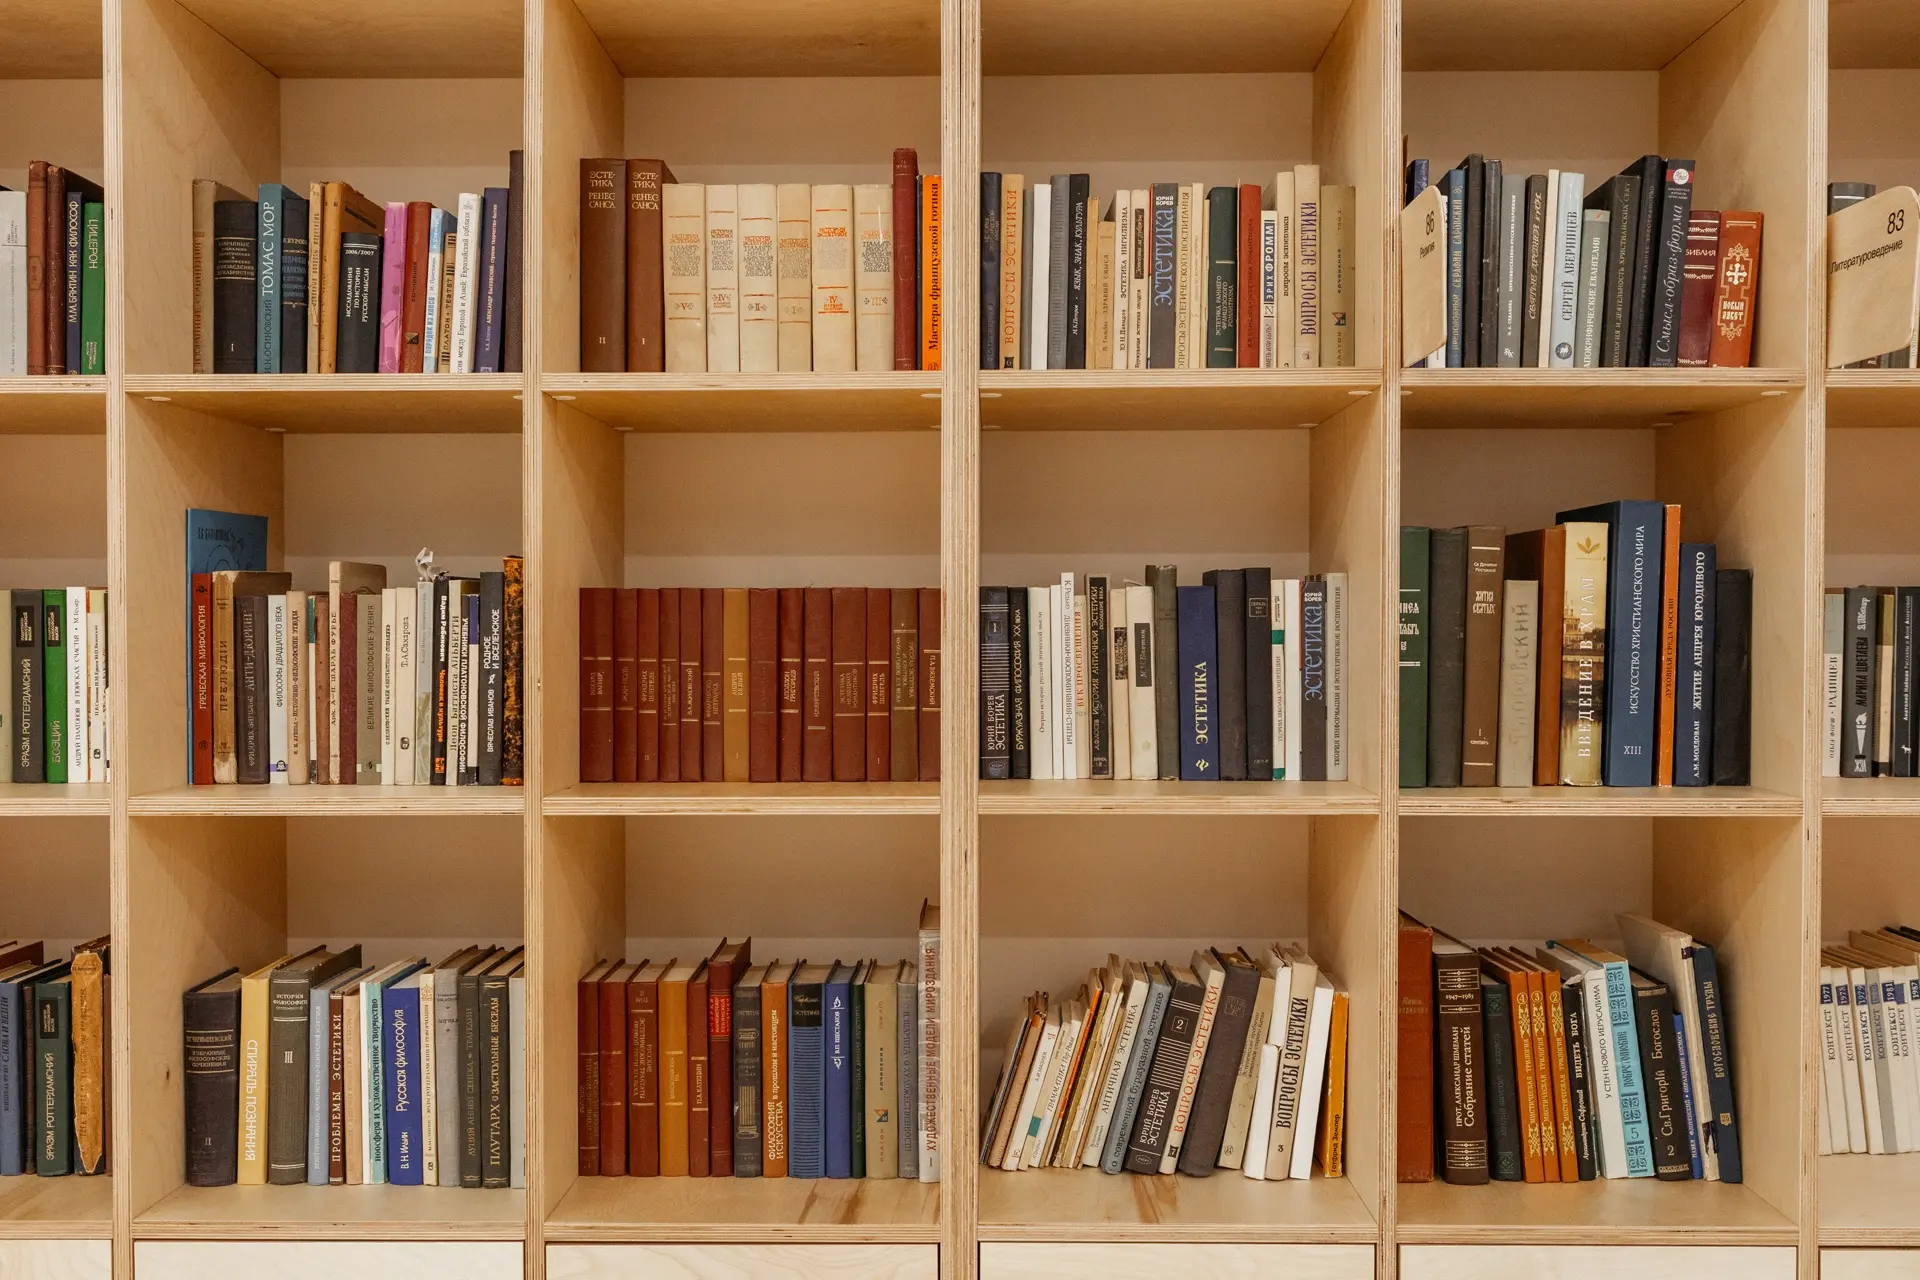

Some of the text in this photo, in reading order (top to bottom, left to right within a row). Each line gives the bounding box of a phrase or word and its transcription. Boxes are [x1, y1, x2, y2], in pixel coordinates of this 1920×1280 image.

[69, 201, 78, 247] ФИЛОСОФ
[632, 202, 658, 210] САНСА
[1006, 190, 1017, 267] ЭСТЕТИКИ
[1426, 211, 1434, 236] 86
[1452, 199, 1462, 244] САРОВСКИЙ
[1887, 209, 1904, 234] 83
[69, 250, 77, 266] КАК
[87, 220, 98, 268] ЦИЦЕРОН
[928, 183, 940, 350] Мастера французской готики
[1265, 225, 1274, 300] ЭРИХ ФРОММ
[1301, 202, 1316, 335] ВОПРОСЫ ЭСТЕТИКИ
[1453, 251, 1462, 288] СЕРАФИМ
[1562, 211, 1577, 321] СЕРГЕЙ АВЕРИНЦЕВ
[1590, 236, 1601, 286] ЕВАНГЕЛИЯ
[1830, 239, 1903, 274] Литературоведение
[355, 299, 360, 308] ПО
[492, 609, 500, 661] ВСЕЛЕНСКОЕ
[1629, 525, 1645, 714] ИСКУССТВО ХРИСТИАНСКОГО МИРА
[1665, 598, 1674, 698] ДУХОВНАЯ СРЕДА РОССИИ
[198, 605, 207, 709] ГРЕЧЕСКАЯ МИФОЛОГИЯ
[367, 636, 375, 694] ФИЛОСОФСКИЕ
[1074, 611, 1084, 707] ВЕК ПРОСВЕЩЕНИЯ
[1578, 577, 1595, 757] ВВЕДЕНИЕ В ХРАМ
[1854, 637, 1869, 707] МАРИНА ЦВЕТАЕВА
[21, 658, 31, 767] ЭРАЗМ РОТТЕРДАМСКИЙ
[367, 696, 375, 730] ВЕЛИКИЕ
[460, 659, 468, 720] ПЛАТОНОВСКОЙ
[987, 695, 995, 722] БОРЕВ
[1195, 661, 1208, 744] ЭСТЕТИКА
[51, 721, 61, 763] БОЭЦИЙ
[995, 694, 1006, 750] ЭСТЕТИКА
[0, 996, 9, 1025] ВЕЩИ
[370, 998, 380, 1043] творчество
[770, 1009, 779, 1051] настоящем
[1176, 1019, 1184, 1030] 2
[1593, 985, 1605, 1037] ИЕРУСАЛИМА
[1702, 981, 1725, 1078] БОГОСЛОВСКИЕ ТРУДЫ
[1822, 986, 1836, 1060] КОНТЕКСТ 1977
[1885, 982, 1900, 1057] КОНТЕКСТ 1981
[1898, 1008, 1909, 1057] КОНТЕКСТ
[1, 1034, 9, 1062] СЛОВА
[394, 1009, 410, 1111] Русская философия
[771, 1059, 780, 1094] прошлом
[925, 948, 938, 1151] ХУДОЖЕСТВЕННЫЕ МОДЕЛИ МИРОЗДАНИЯ
[1101, 1004, 1138, 1114] АНТИЧНАЯ ЭСТЕТИКА
[1113, 1096, 1135, 1157] современной
[1129, 1038, 1150, 1094] буржуазной
[1146, 992, 1164, 1036] эстетике
[1173, 985, 1219, 1133] ВОПРОСЫ ЭСТЕТИКИ
[1275, 997, 1309, 1129] ВОПРОСЫ ЭСТЕТИКИ
[1461, 1026, 1476, 1127] Собрание статей
[1599, 1038, 1610, 1072] НОВОГО
[44, 1053, 55, 1160] ЭРАЗМ РОТТЕРДАМСКИЙ
[244, 1040, 258, 1161] СПИРАЛЬ ПОЗНАНИЯ
[332, 1014, 341, 1162] ПРОБЛЕМЫ ЭСТЕТИКИ
[371, 1045, 381, 1111] художественное
[490, 997, 500, 1165] ПЛУТАРХ ЗАСТОЛЬНЫЕ БЕСЕДЫ
[1604, 1073, 1612, 1092] СТЕН
[373, 1122, 382, 1162] ноосфера
[400, 1132, 409, 1154] Ильин
[767, 1101, 778, 1160] ФИЛОСОФИЯ
[776, 1101, 785, 1158] ИСКУССТВА
[1139, 1088, 1160, 1144] ЮРИЙ БОРЕВ
[1147, 1091, 1171, 1146] ЭСТЕТИКА
[1330, 1114, 1340, 1173] Готфрид Земпер
[1630, 1127, 1639, 1140] 5
[1666, 1145, 1675, 1156] 2
